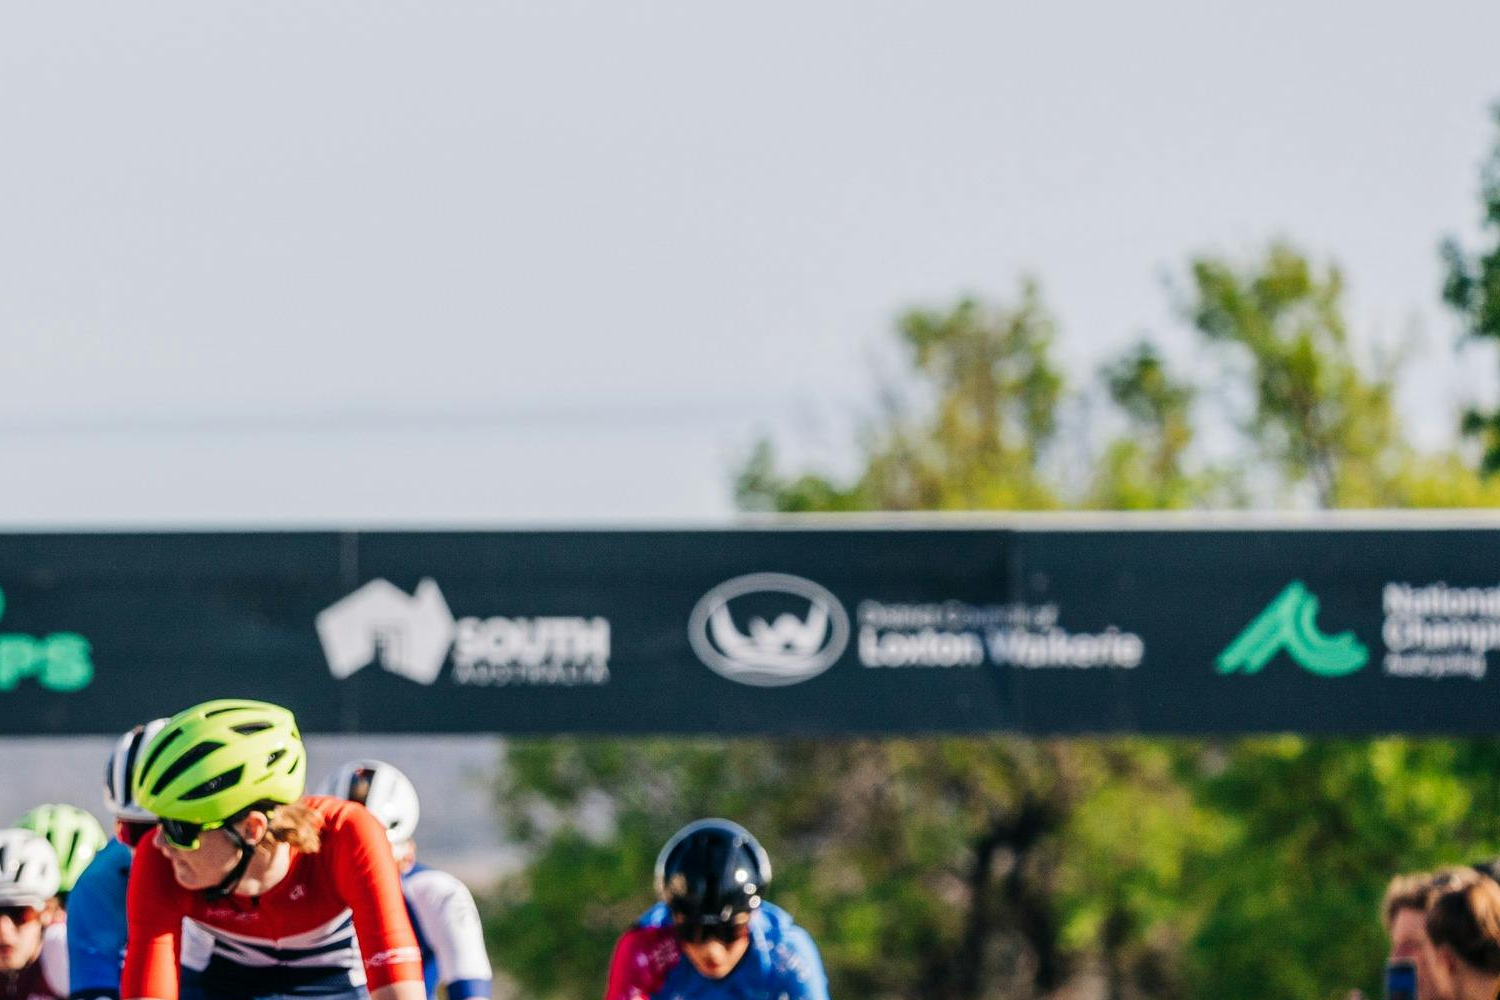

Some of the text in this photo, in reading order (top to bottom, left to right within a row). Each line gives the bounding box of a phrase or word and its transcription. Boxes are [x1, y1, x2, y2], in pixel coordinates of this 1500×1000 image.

[1383, 581, 1500, 616] Nationa
[454, 616, 611, 664] SOUTH
[858, 625, 984, 667] Loxton
